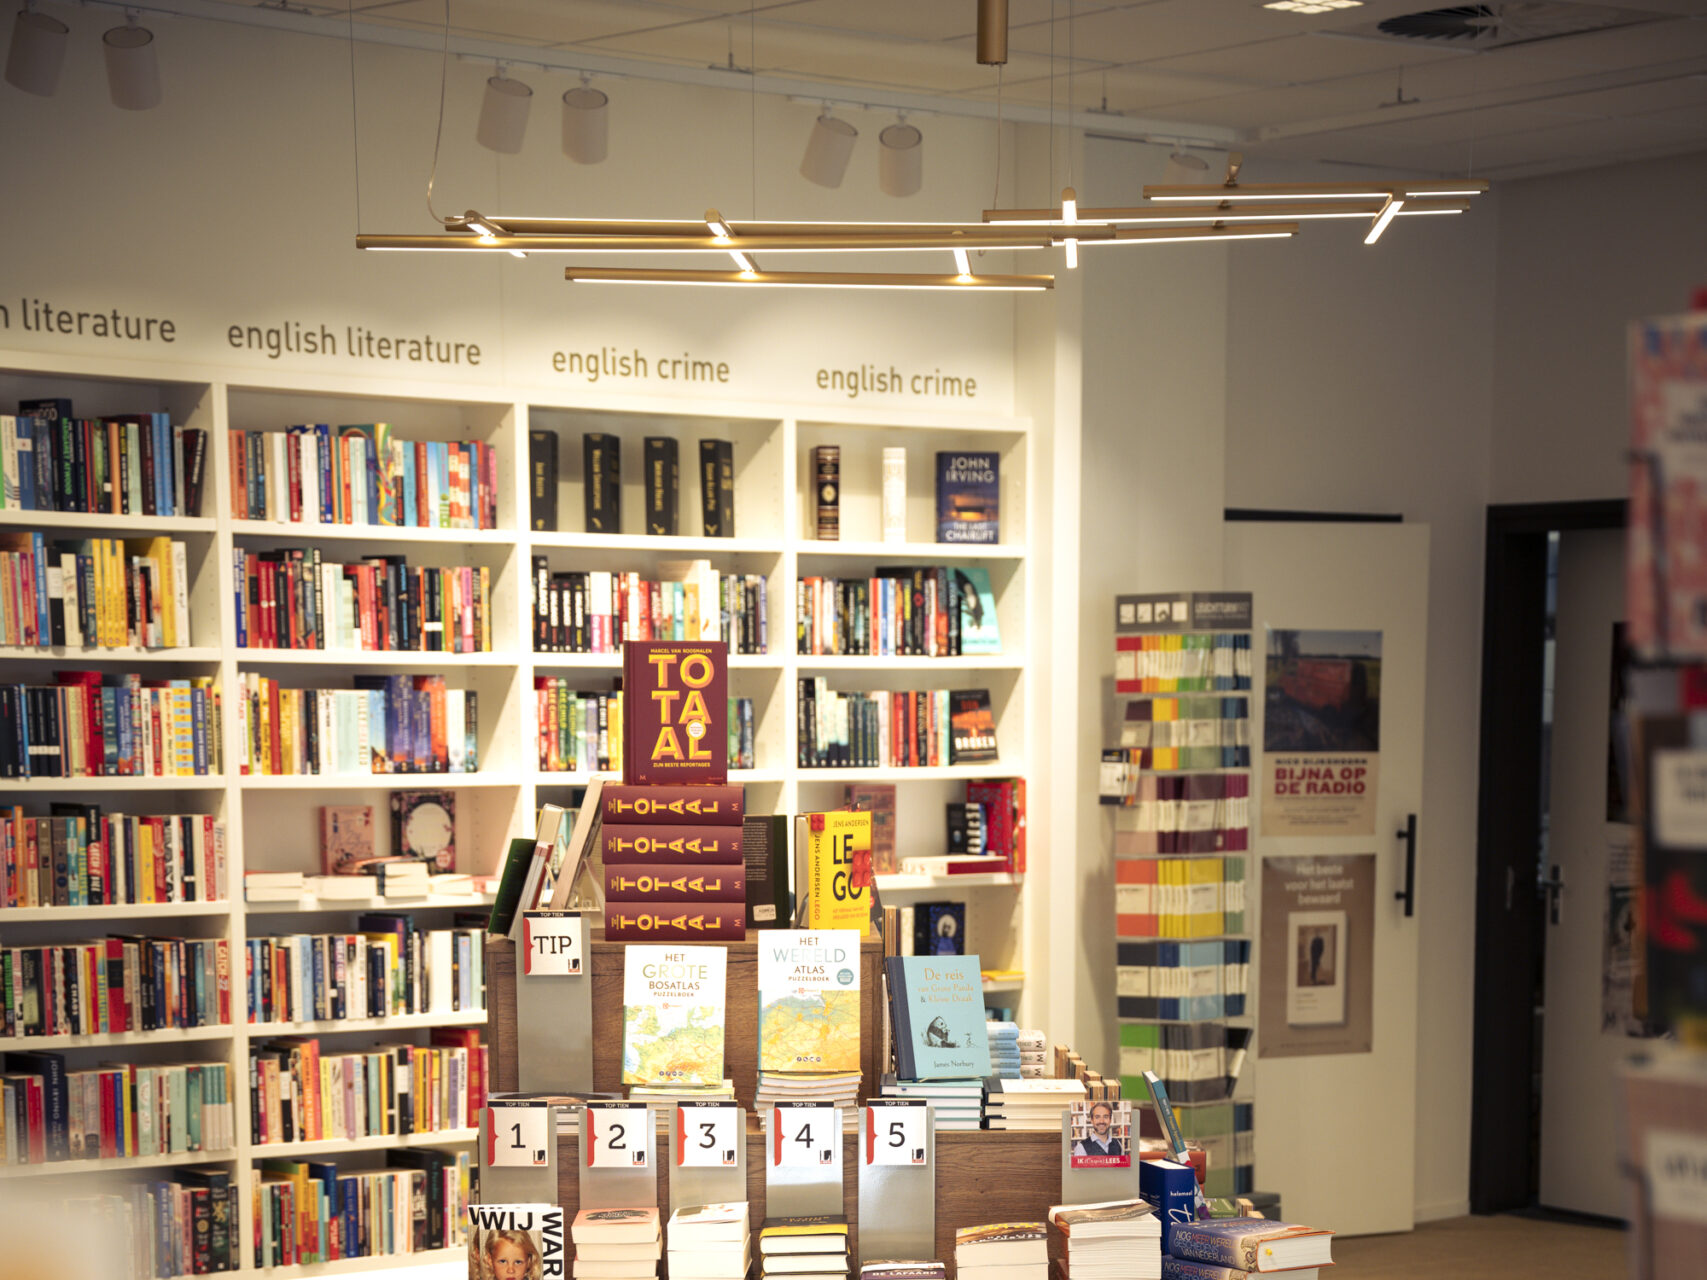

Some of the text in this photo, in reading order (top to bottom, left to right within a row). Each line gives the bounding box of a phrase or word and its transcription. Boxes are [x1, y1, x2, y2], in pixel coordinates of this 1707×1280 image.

[22, 298, 176, 342] literature
[228, 322, 481, 366] english literature
[552, 346, 730, 383] english crime
[816, 365, 977, 398] english crime
[950, 456, 990, 470] JOHN
[945, 470, 995, 483] IRVING
[648, 653, 715, 689] TO
[651, 690, 712, 724] TA
[651, 726, 712, 760] AL
[1275, 767, 1367, 780] BIJNA OP
[1274, 781, 1366, 795] DE RADIO
[617, 798, 719, 815] TOTAAL
[617, 836, 719, 853] TOTAAL
[833, 834, 854, 865] LE
[619, 875, 721, 892] TOTAAL
[832, 870, 863, 901] GO
[619, 914, 721, 931] TOTAAL
[533, 935, 572, 955] TIP
[799, 936, 820, 946] HET
[665, 953, 686, 963] HET
[773, 947, 847, 964] WERELD
[641, 963, 708, 980] GROTE
[794, 965, 825, 975] ATLAS
[924, 967, 965, 981] De reis
[649, 980, 701, 991] BOSATLAS
[933, 1059, 974, 1069] James Norbury
[510, 1122, 526, 1149] 1
[608, 1124, 627, 1150] 2
[698, 1123, 716, 1149] 3
[794, 1123, 814, 1149] 4
[888, 1122, 906, 1148] 5
[480, 1211, 533, 1231] WIJ
[1175, 1230, 1192, 1241] NOG
[1192, 1233, 1209, 1244] MEER
[1182, 1247, 1235, 1265] VAN NEDERLAND
[1164, 1261, 1180, 1271] NOG
